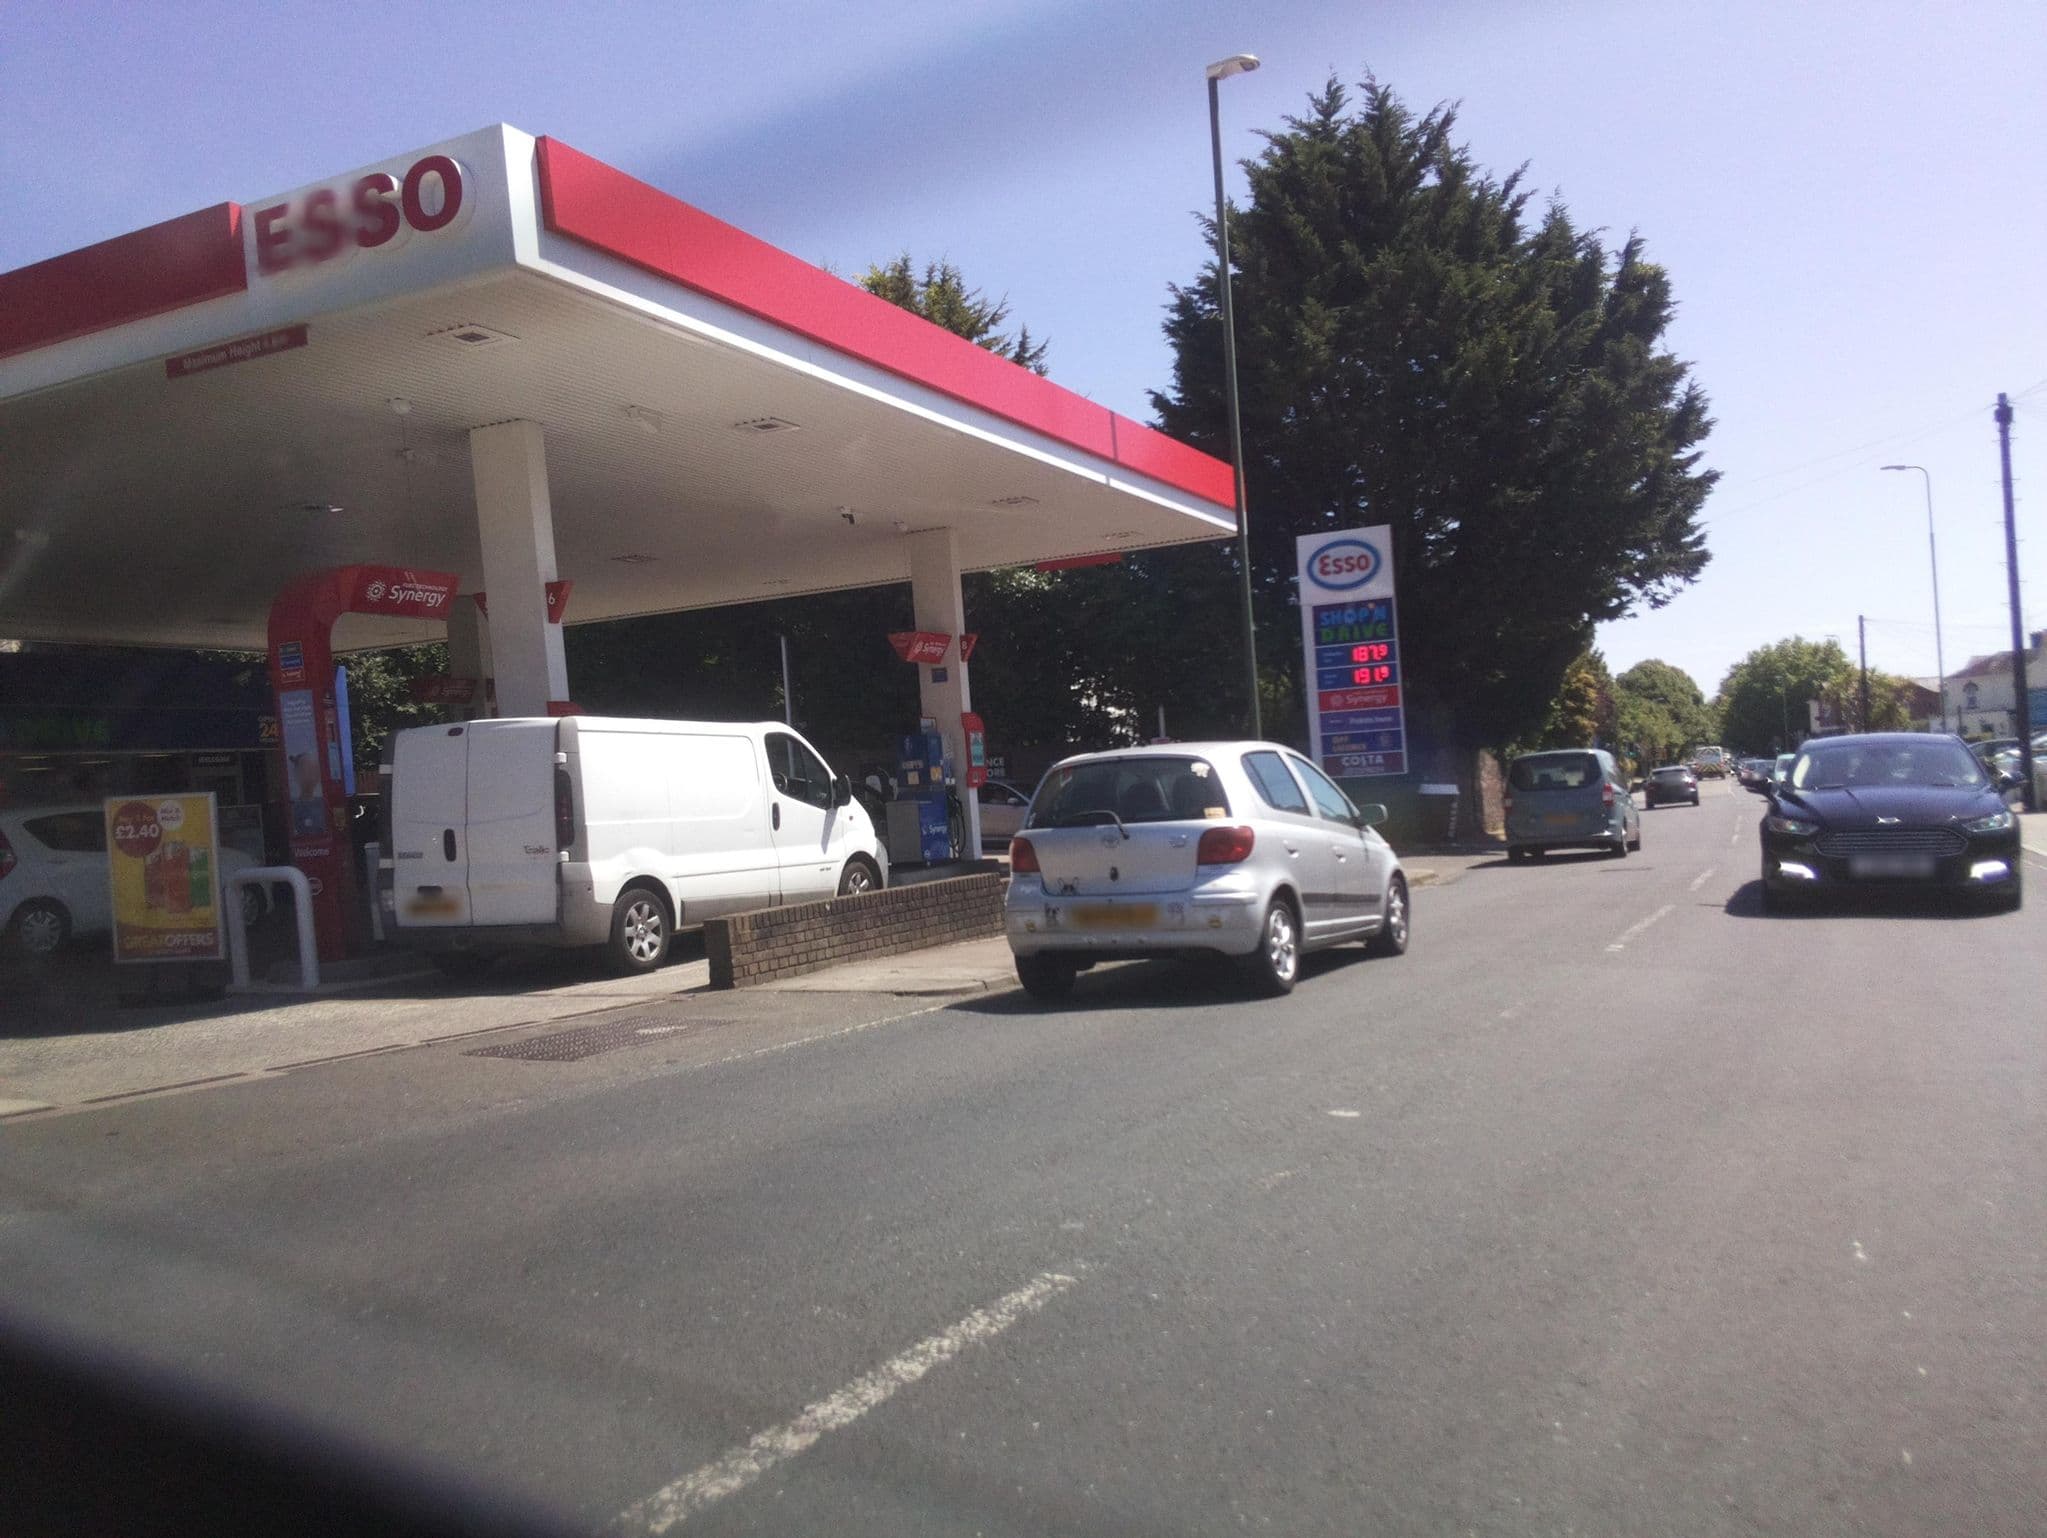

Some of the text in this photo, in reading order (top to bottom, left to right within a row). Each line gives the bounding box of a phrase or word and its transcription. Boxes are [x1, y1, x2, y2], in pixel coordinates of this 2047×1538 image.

[254, 154, 463, 277] ESSO
[388, 585, 447, 607] Synergy
[548, 593, 556, 605] 6
[1346, 694, 1388, 706] Synergy
[1341, 755, 1385, 767] COSTA
[115, 823, 160, 840] £2.40
[294, 847, 330, 857] Welcome
[165, 932, 214, 947] OFFERS
